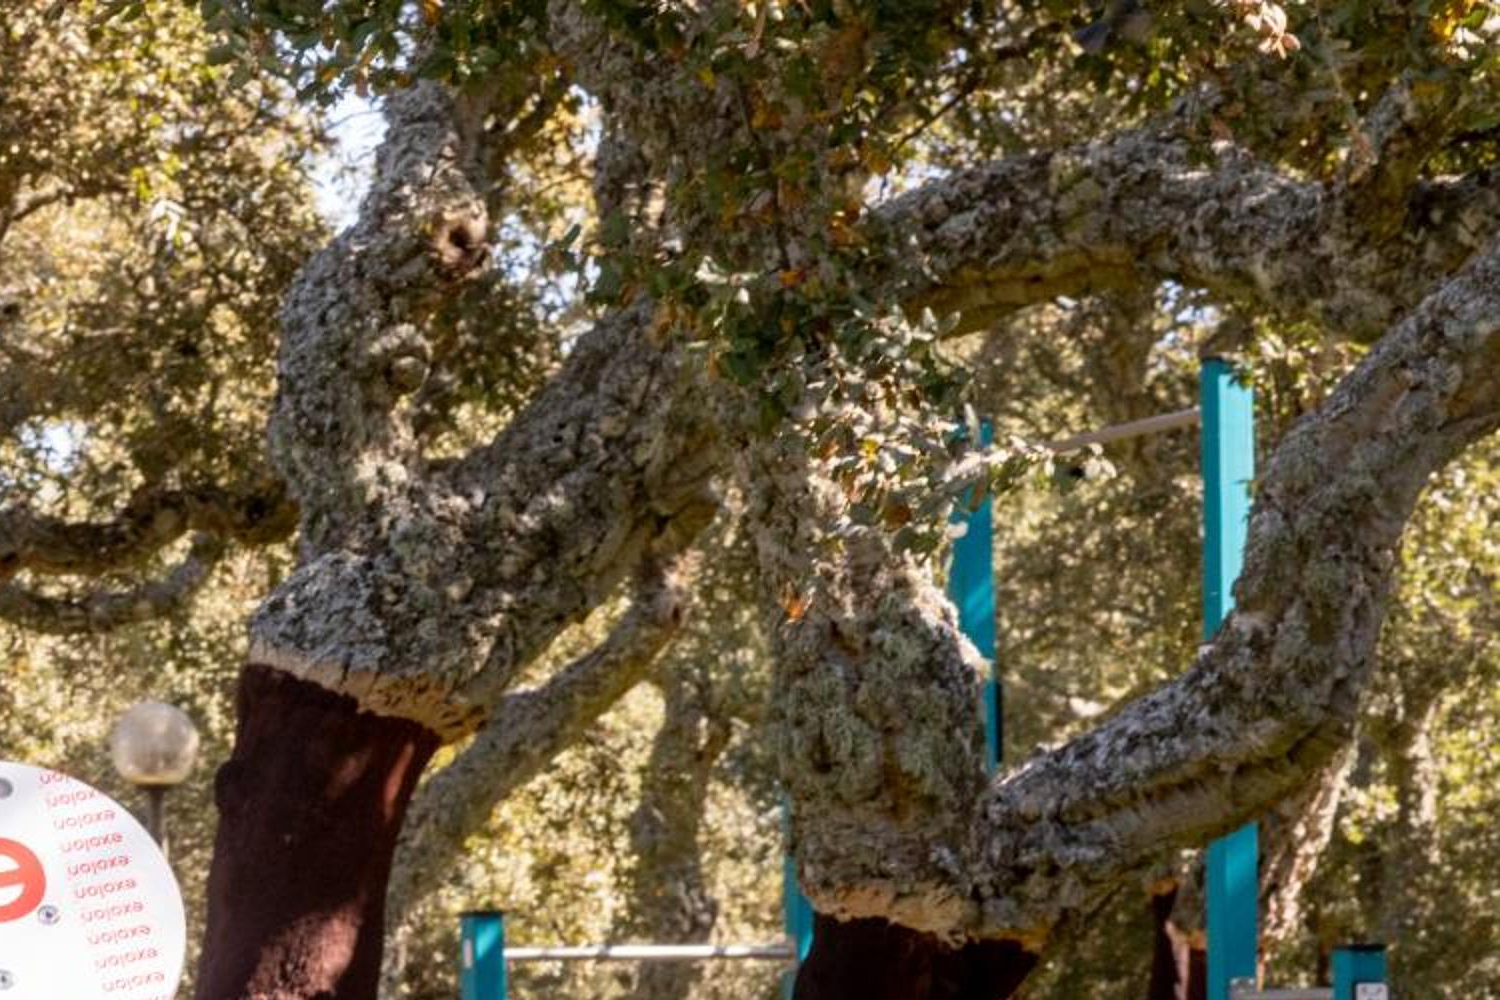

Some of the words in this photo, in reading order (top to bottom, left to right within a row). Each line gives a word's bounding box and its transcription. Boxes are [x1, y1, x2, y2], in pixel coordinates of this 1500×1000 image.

[53, 809, 116, 829] exolon
[61, 832, 123, 852] exolon
[68, 855, 130, 875] exolon
[75, 879, 136, 899] exolon
[82, 901, 144, 922] exolon
[88, 926, 150, 944] exolon
[95, 947, 158, 968] exolon
[102, 971, 164, 992] exolon
